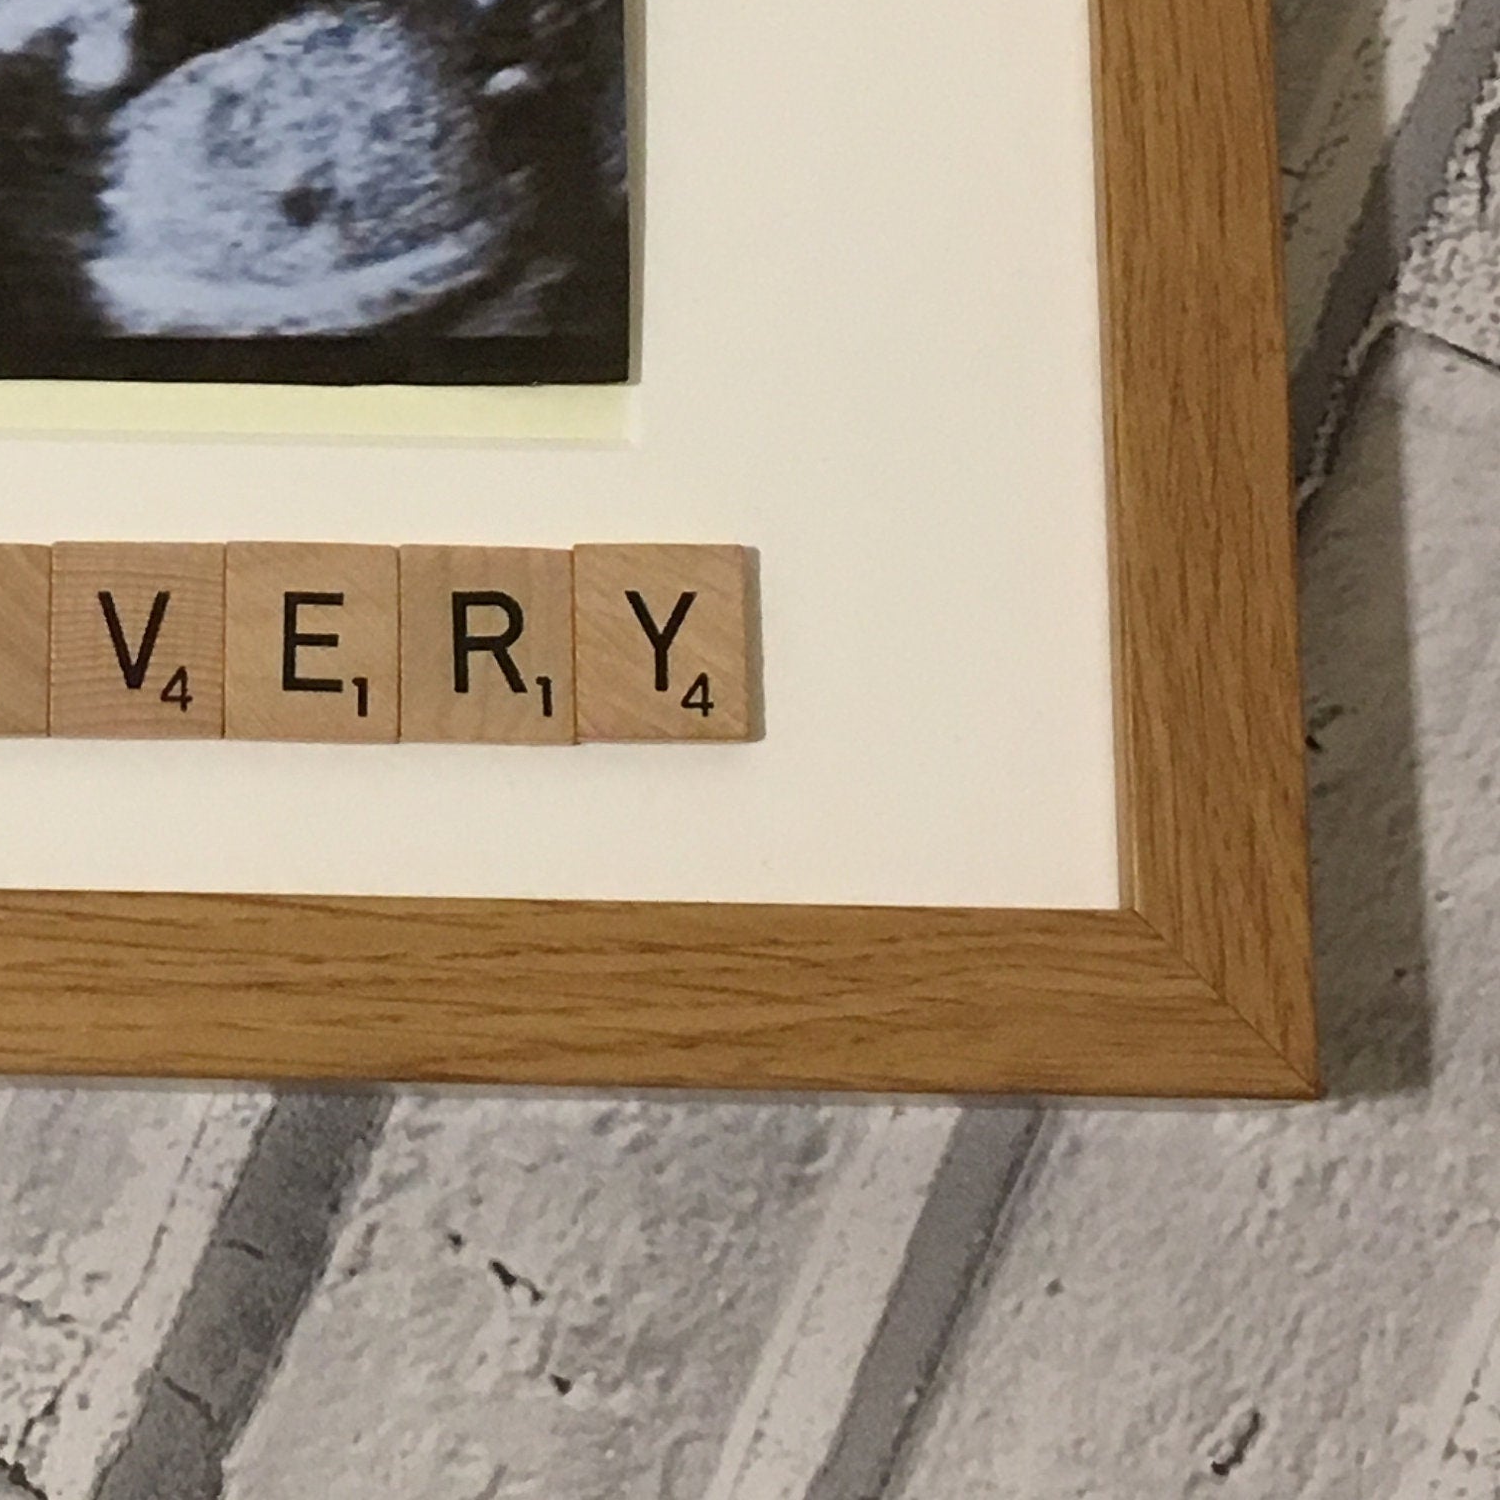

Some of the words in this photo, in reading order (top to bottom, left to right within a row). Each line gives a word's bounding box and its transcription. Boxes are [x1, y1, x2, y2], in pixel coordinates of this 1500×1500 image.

[159, 666, 194, 714] 4
[350, 676, 369, 719] 1
[534, 675, 554, 719] 1
[679, 671, 716, 719] 4
